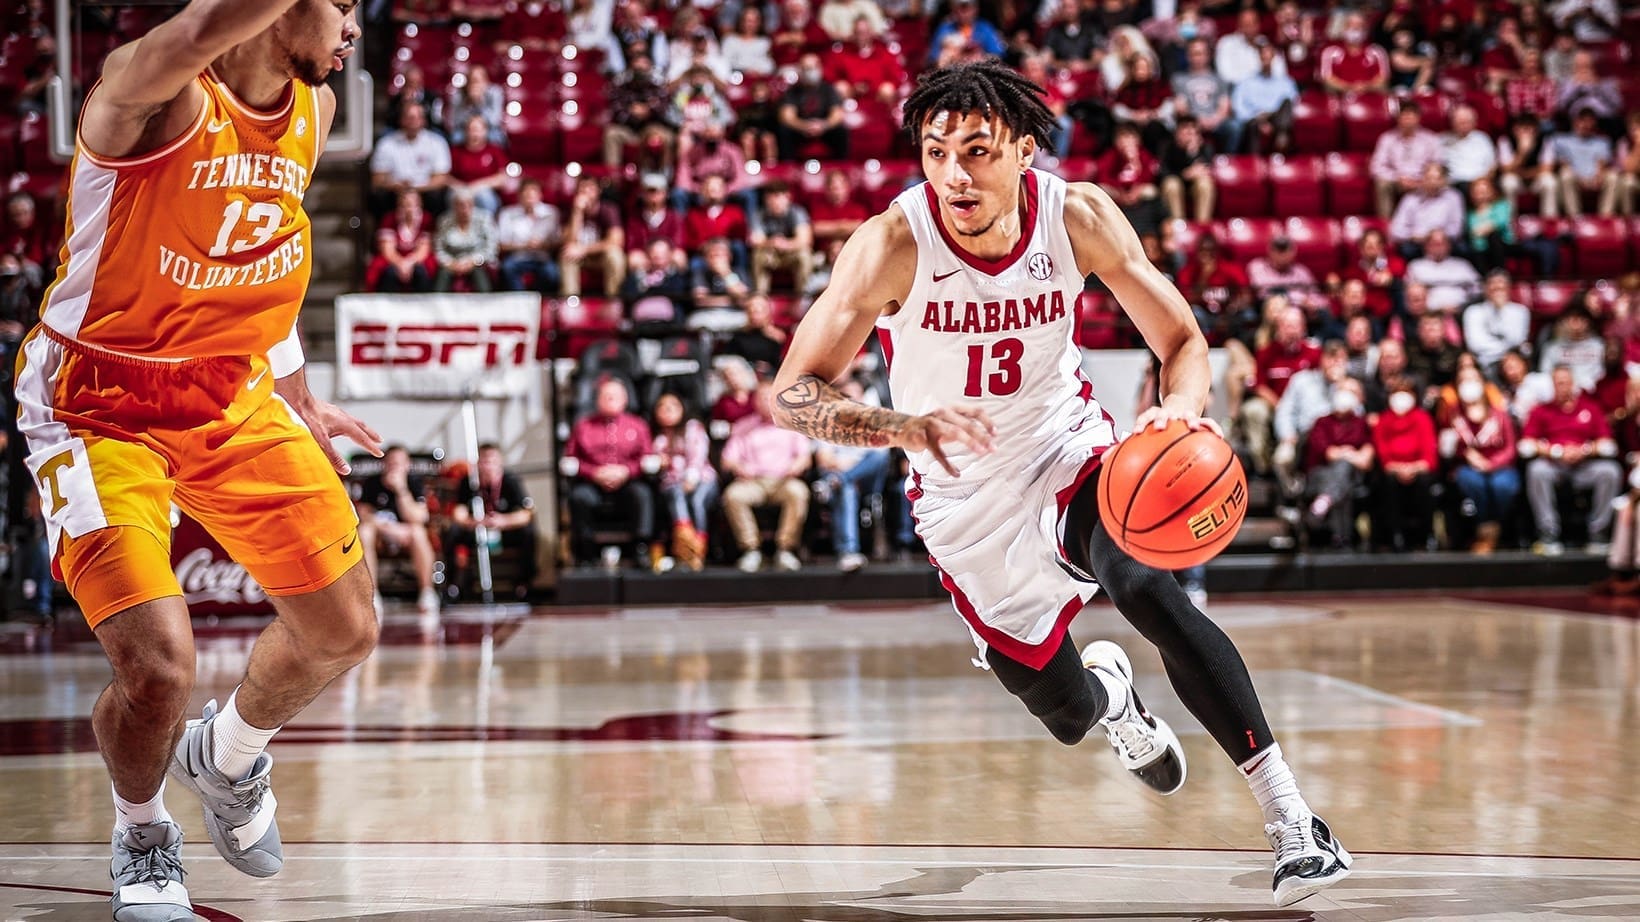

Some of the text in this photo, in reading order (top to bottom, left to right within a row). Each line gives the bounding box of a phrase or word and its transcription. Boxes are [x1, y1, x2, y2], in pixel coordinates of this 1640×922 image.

[208, 199, 284, 258] 13
[159, 230, 305, 291] VOLUNTEERS
[920, 290, 1066, 334] ALABAMA
[351, 323, 528, 367] ESPN
[963, 337, 1025, 398] 13
[36, 448, 75, 518] T
[1190, 478, 1247, 541] ELITE
